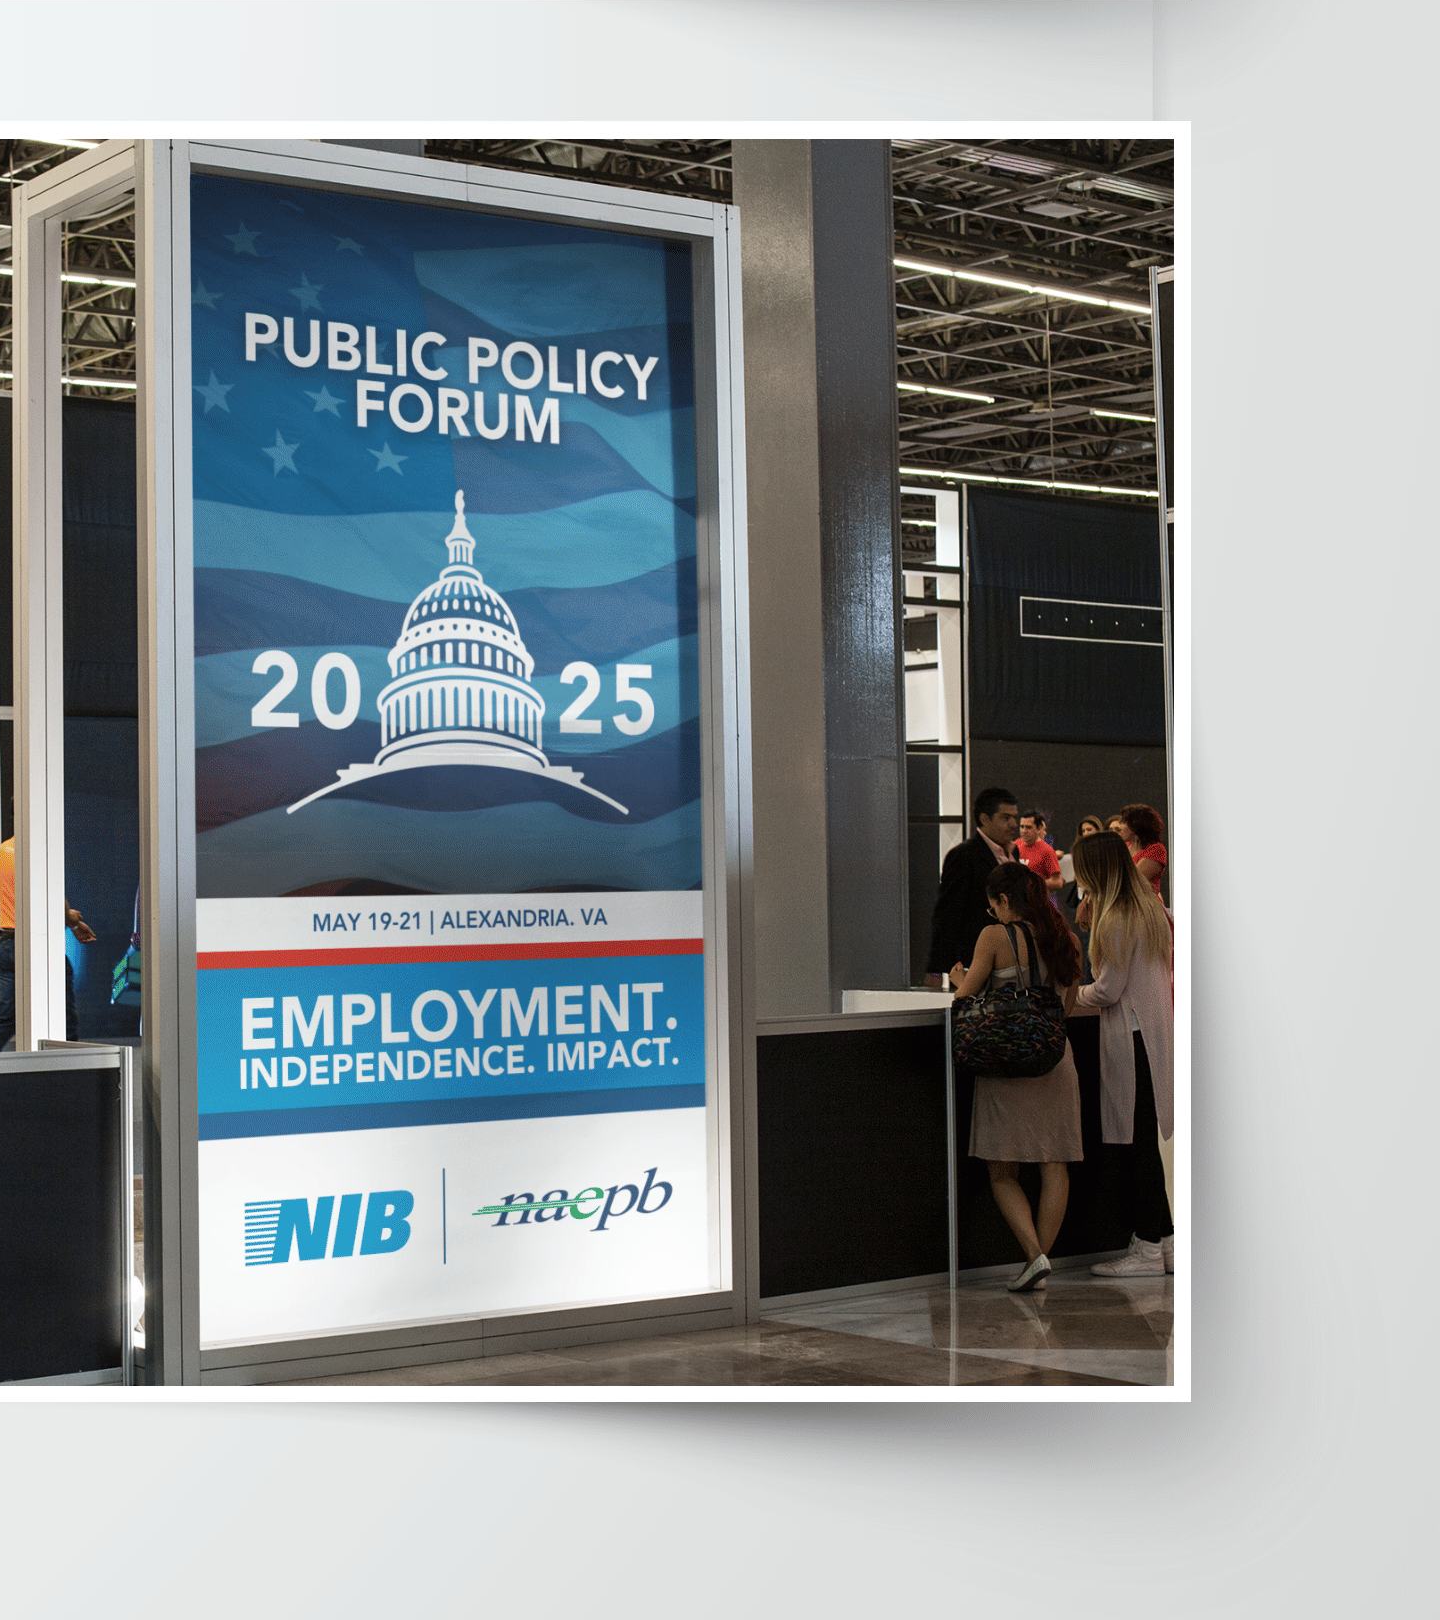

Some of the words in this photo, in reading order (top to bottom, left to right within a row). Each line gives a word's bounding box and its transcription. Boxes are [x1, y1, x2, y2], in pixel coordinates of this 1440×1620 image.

[246, 313, 448, 381] PUBLIC
[468, 337, 658, 400] POLICY
[357, 379, 560, 444] FORUM
[251, 649, 361, 730] 20
[559, 661, 655, 736] 25
[313, 912, 361, 932] MAY
[368, 911, 420, 931] 19-21
[580, 907, 608, 926] VA
[241, 982, 679, 1051] EMPLOYMENT.
[240, 1045, 534, 1090] INDEPENDENCE.
[548, 1037, 679, 1072] IMPACT.
[244, 1189, 415, 1267] NIB
[471, 1167, 673, 1232] naepb
